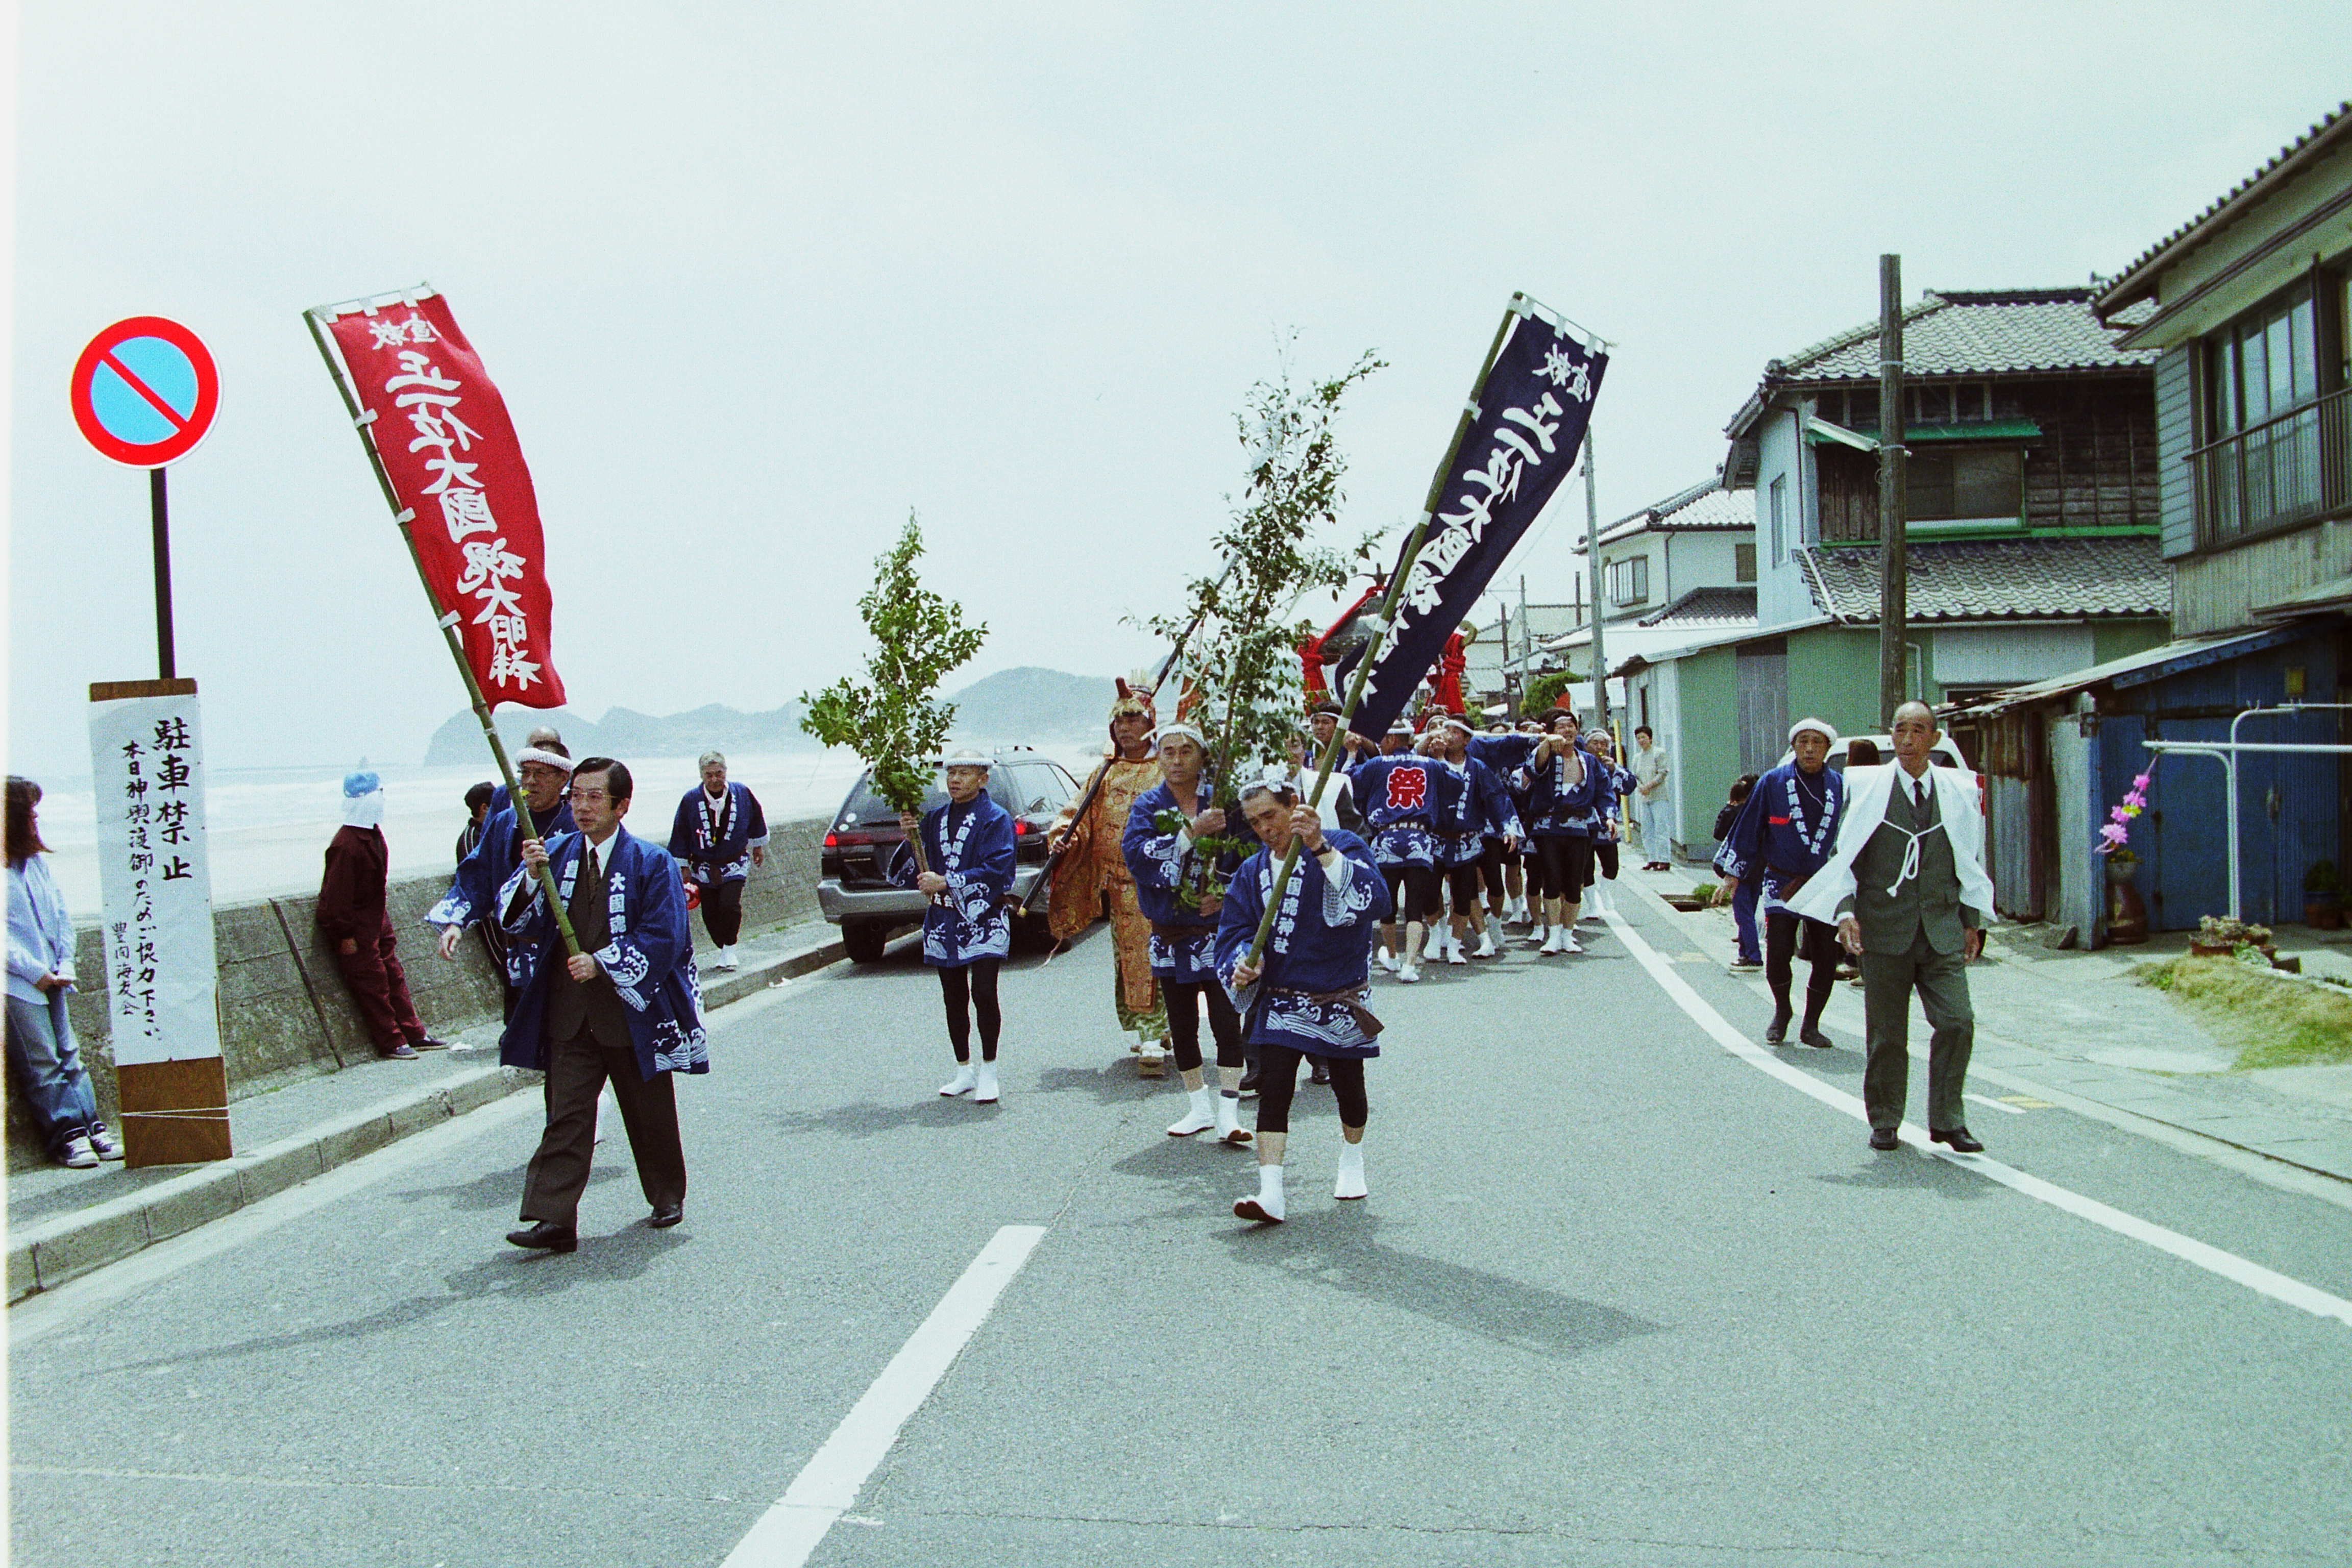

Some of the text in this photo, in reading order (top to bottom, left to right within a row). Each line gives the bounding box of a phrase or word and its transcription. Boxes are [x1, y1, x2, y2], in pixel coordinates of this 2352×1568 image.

[153, 717, 193, 881] 駐車禁止
[1386, 767, 1427, 810] 祭
